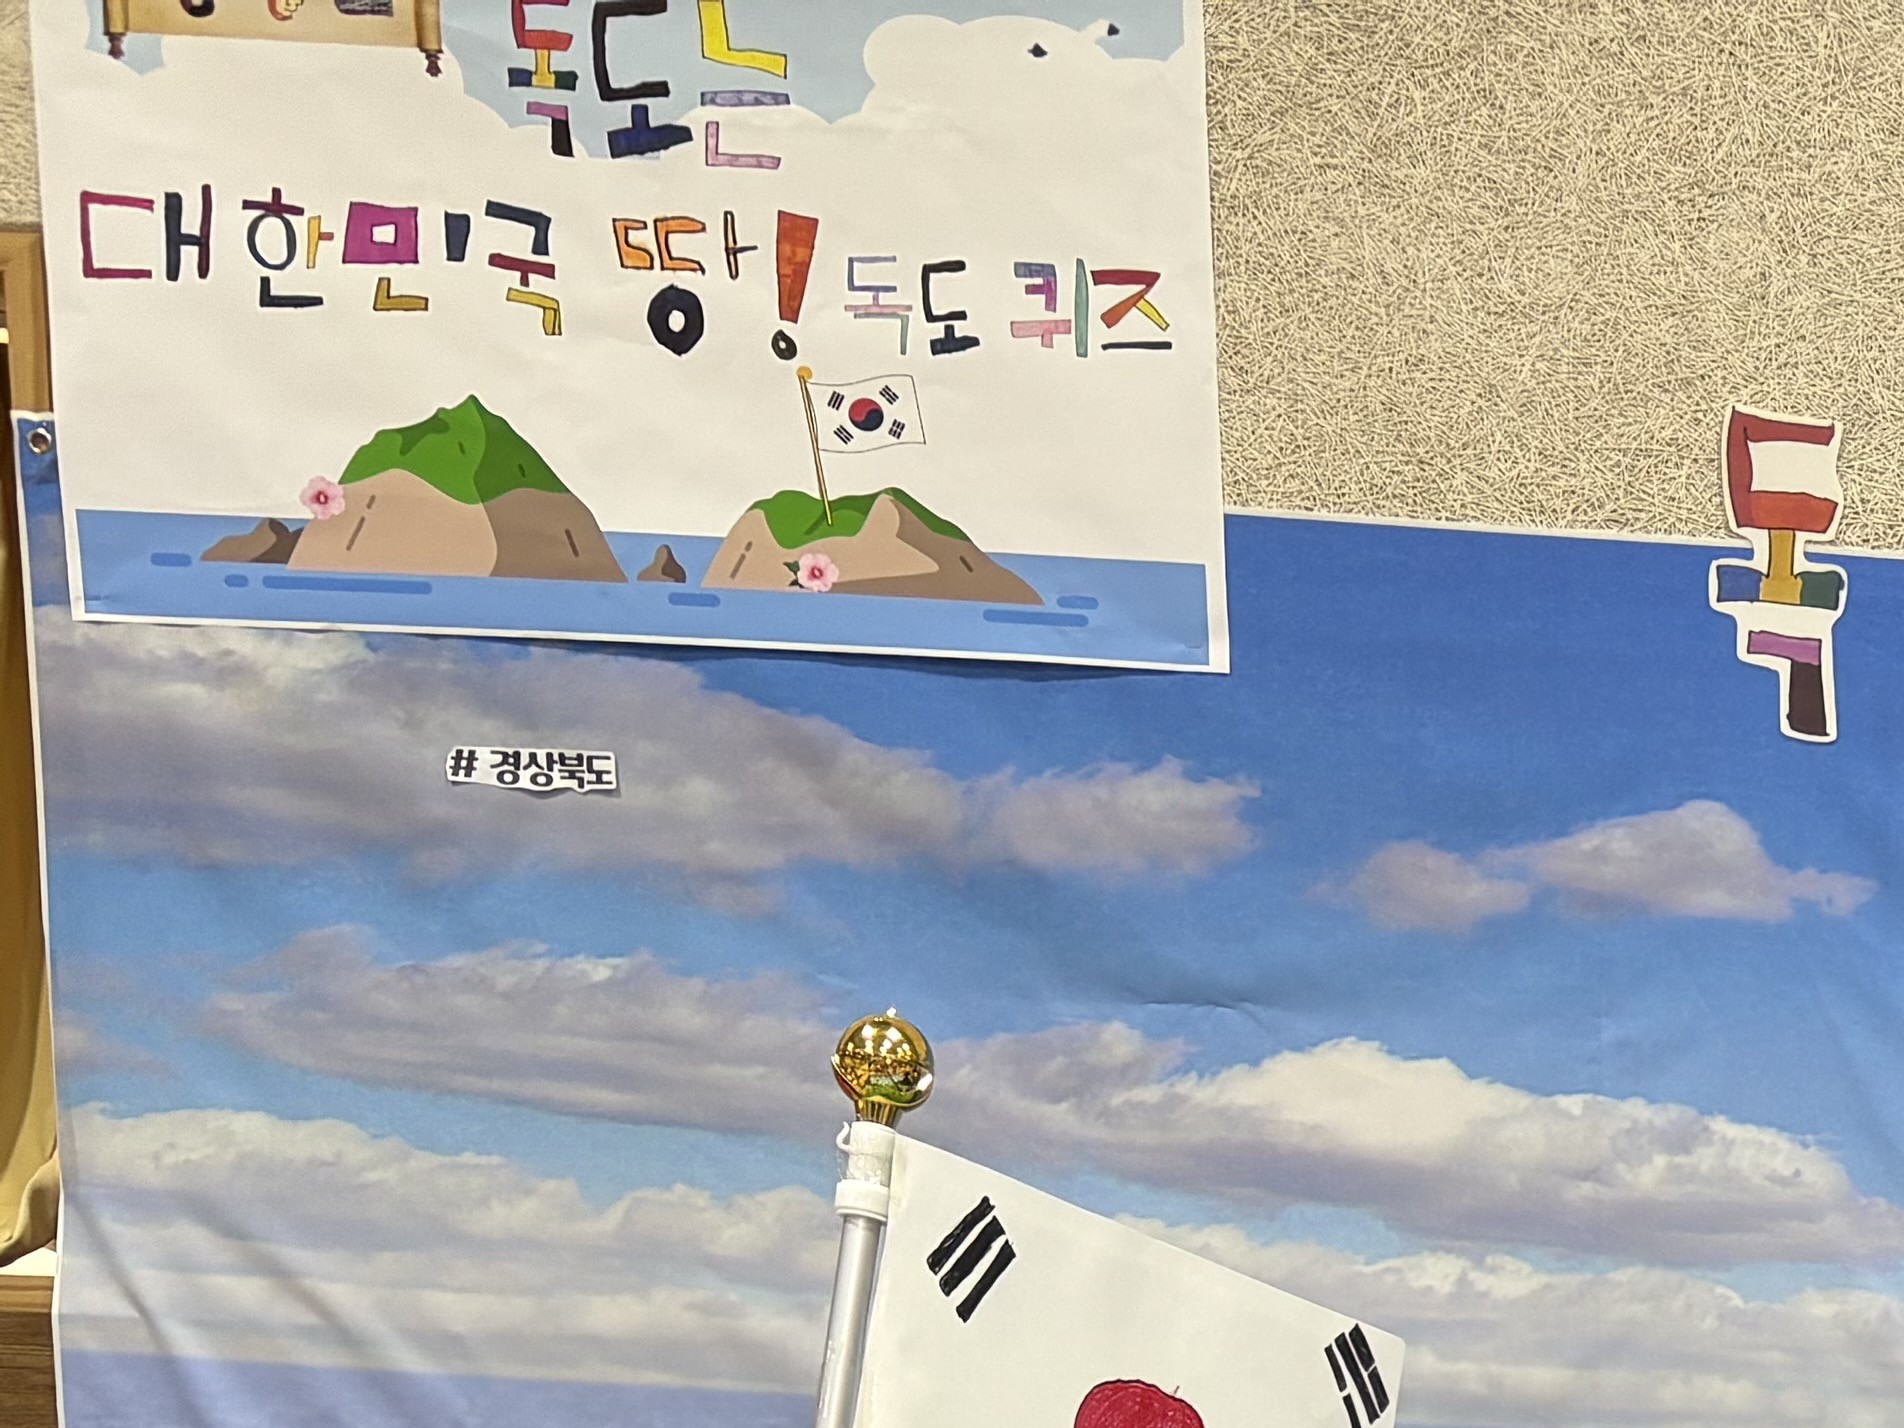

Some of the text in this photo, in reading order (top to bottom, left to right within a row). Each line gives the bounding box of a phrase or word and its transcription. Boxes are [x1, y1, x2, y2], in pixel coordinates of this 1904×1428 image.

[508, 0, 791, 169] 독도는
[80, 183, 1173, 361] 대한민국 땅! 독도 퀴즈
[449, 748, 614, 789] # 경상북도
